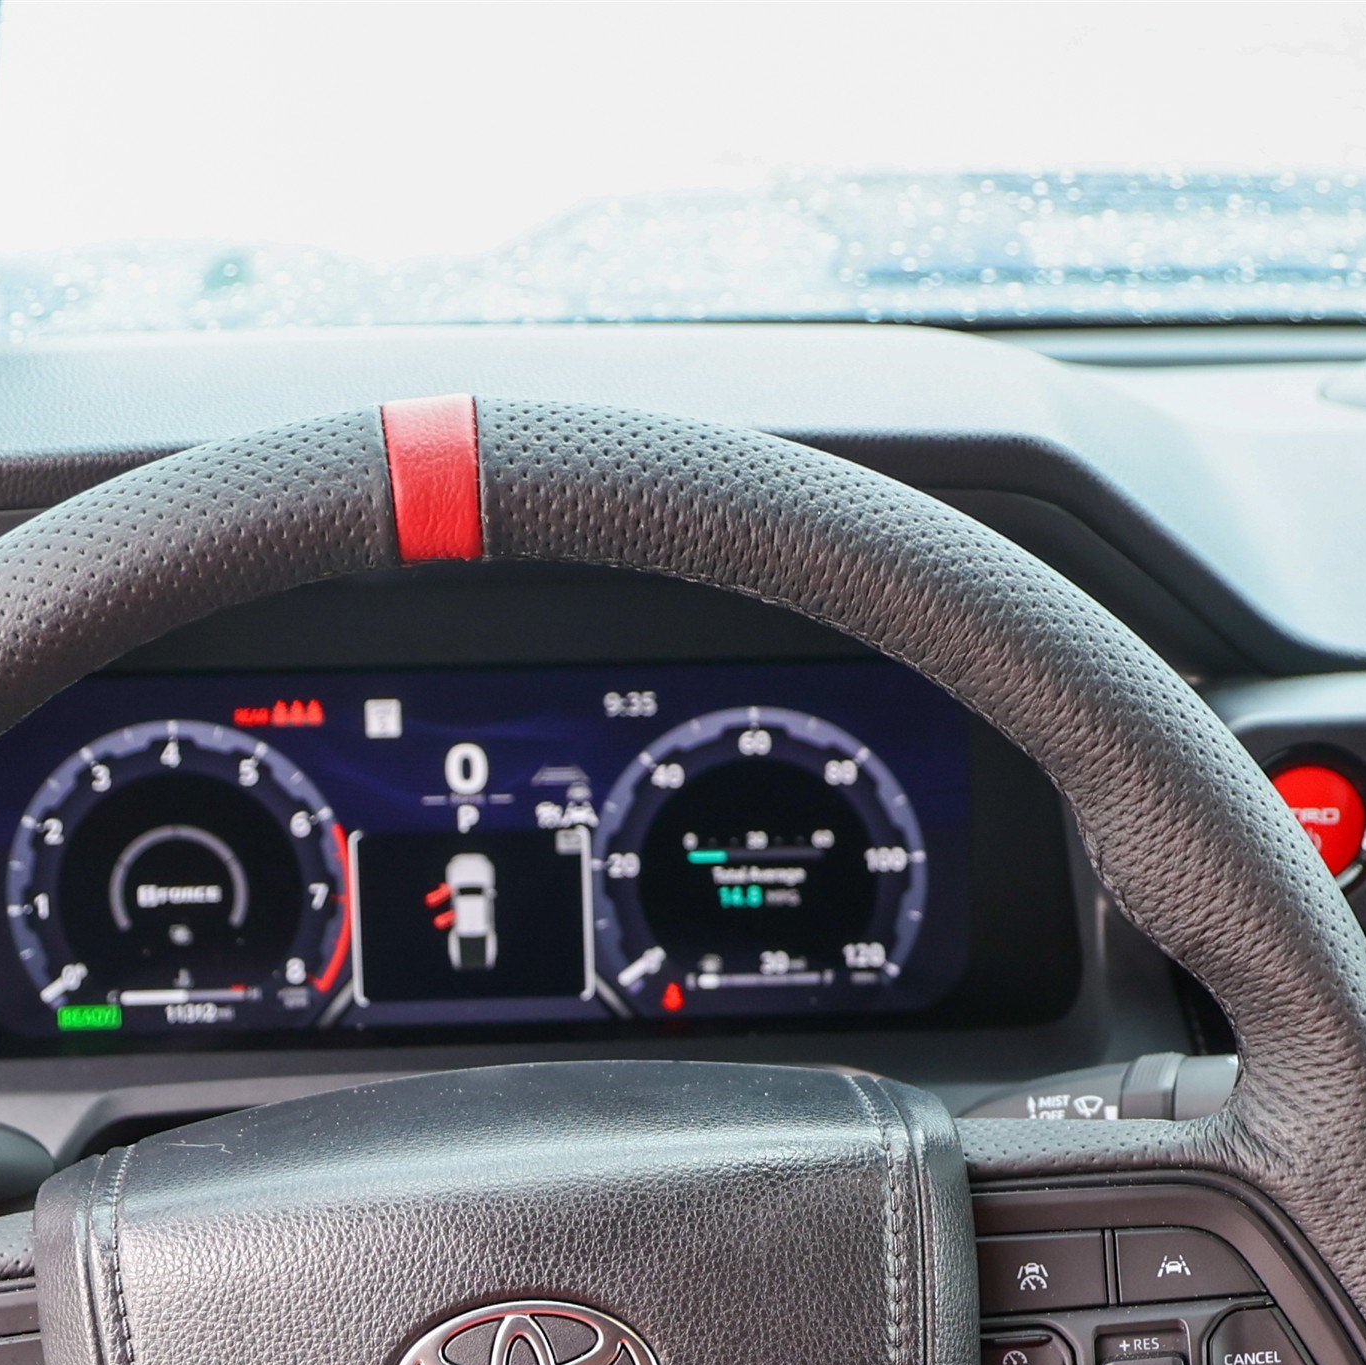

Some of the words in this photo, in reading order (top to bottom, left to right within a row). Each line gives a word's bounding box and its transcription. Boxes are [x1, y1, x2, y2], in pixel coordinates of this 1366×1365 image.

[603, 691, 658, 717] 9:35
[160, 742, 181, 768] 4
[738, 730, 772, 757] 60
[91, 764, 112, 792] 3
[239, 759, 259, 786] 5
[444, 742, 489, 795] 0
[651, 763, 685, 789] 40
[824, 759, 858, 786] 80
[44, 818, 64, 845] 2
[291, 811, 312, 838] 6
[457, 804, 480, 834] P
[607, 852, 641, 879] 20
[865, 847, 907, 872] 100
[34, 892, 50, 919] 1
[309, 883, 329, 910] 7
[843, 942, 885, 970] 120
[285, 957, 306, 985] 8
[1038, 1094, 1070, 1109] MIST
